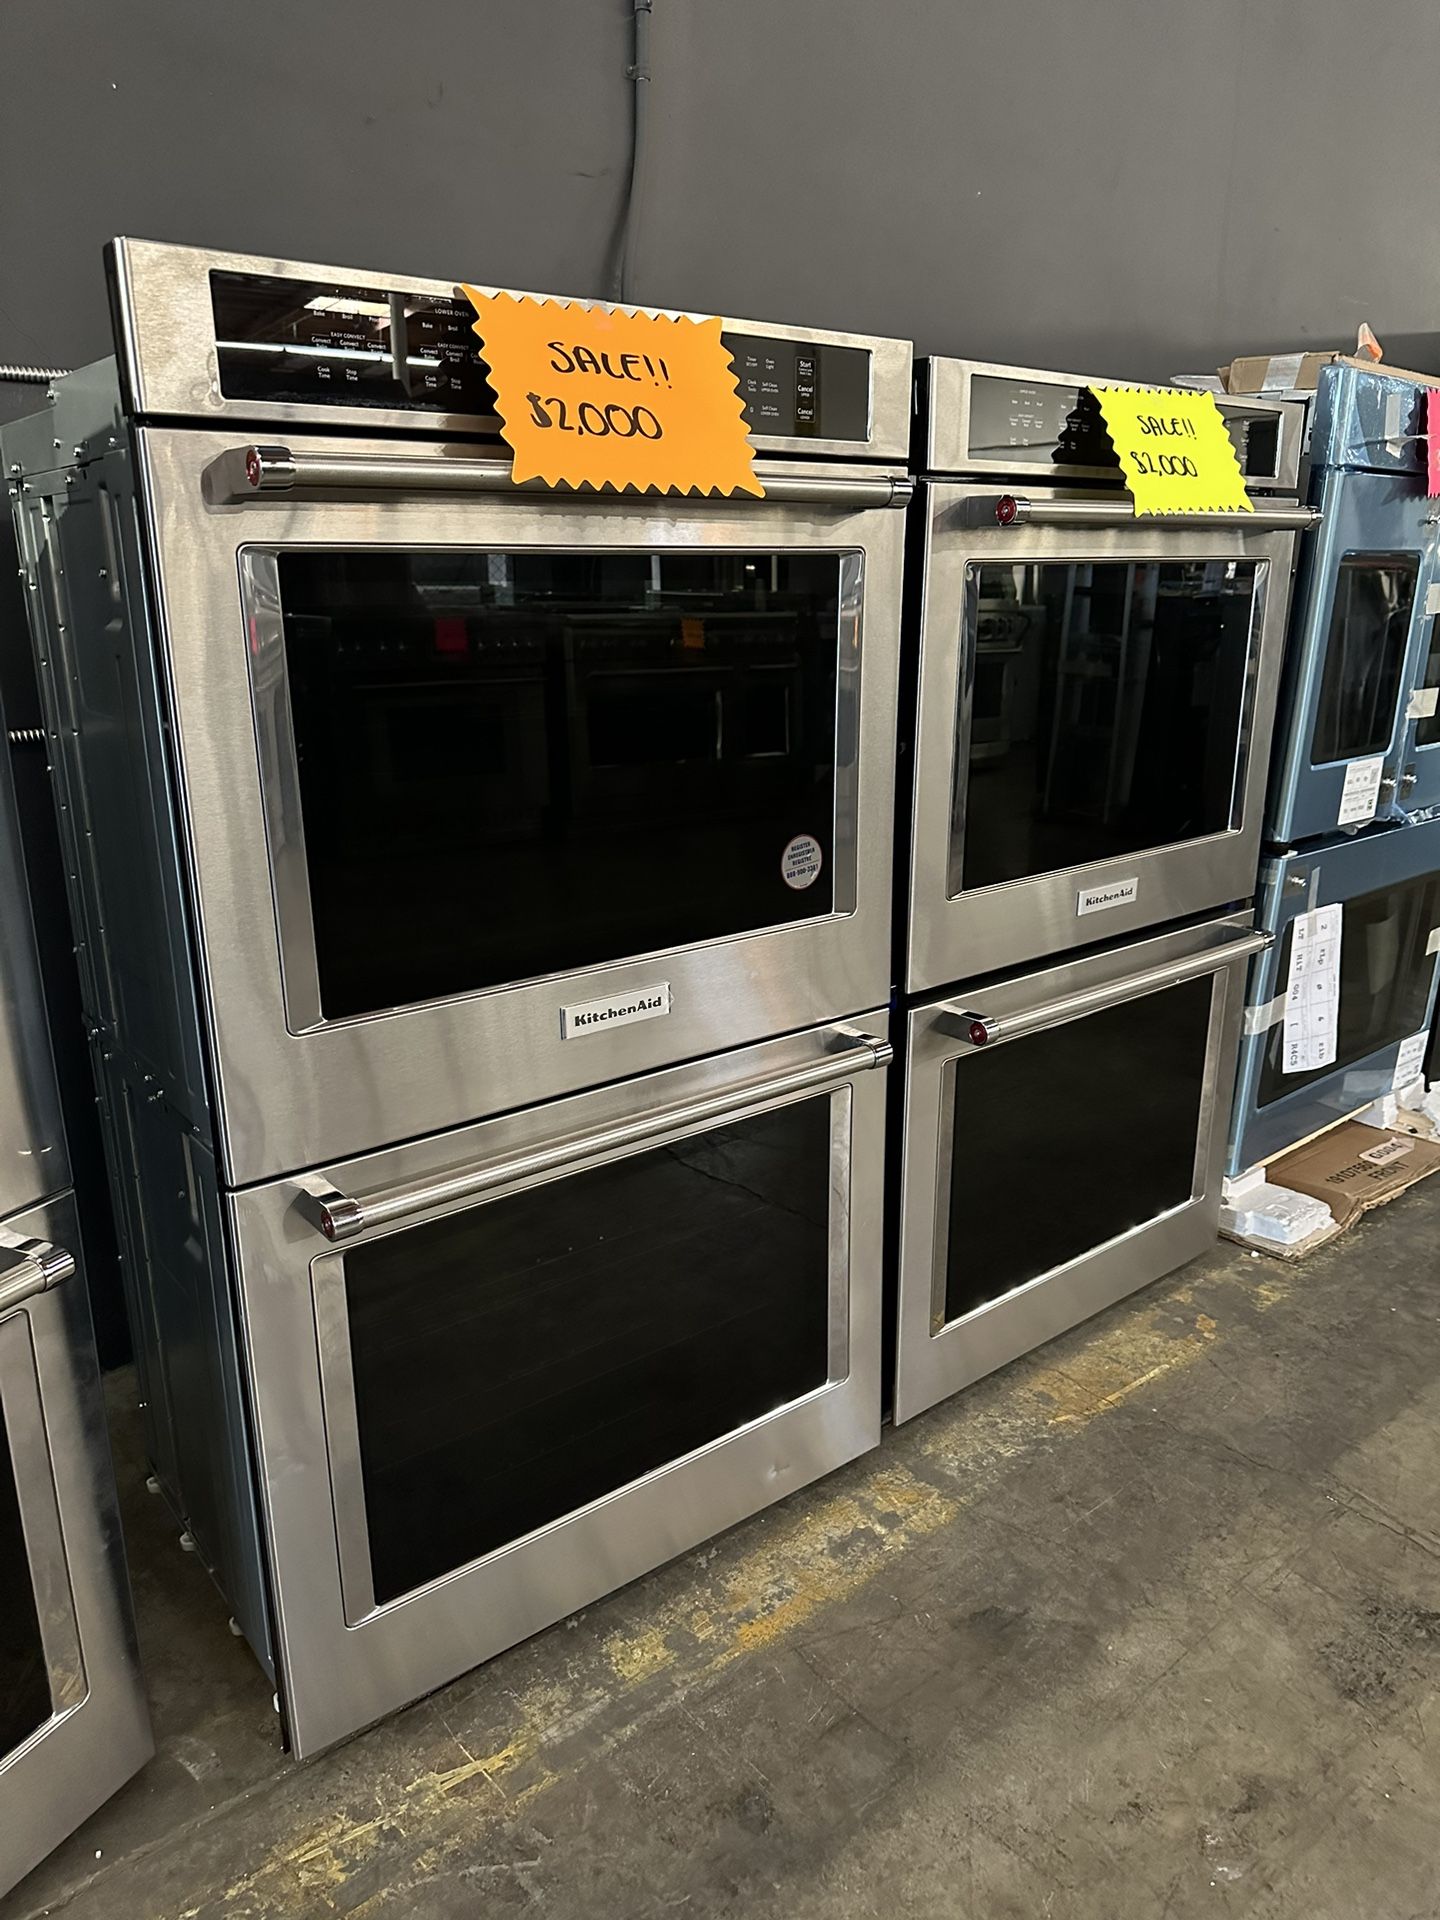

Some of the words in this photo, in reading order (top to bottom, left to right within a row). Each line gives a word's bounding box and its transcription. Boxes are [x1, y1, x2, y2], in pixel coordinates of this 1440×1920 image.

[434, 308, 453, 316] LOWER
[311, 336, 332, 344] Convect
[343, 332, 366, 340] CONVECT
[340, 340, 359, 348] Convect
[367, 342, 386, 350] Convect
[420, 347, 438, 355] Convect
[445, 350, 463, 358] Convect
[547, 341, 673, 389] SALE!!
[800, 360, 812, 368] Start
[346, 368, 357, 376] Stop
[797, 384, 813, 393] Cancel
[526, 391, 664, 440] $2,000
[797, 408, 813, 416] Cancel
[1136, 414, 1197, 440] SALE!!
[1130, 450, 1198, 478] $2,000
[1085, 887, 1134, 906] KitchenAid
[574, 996, 662, 1027] KitchenAid
